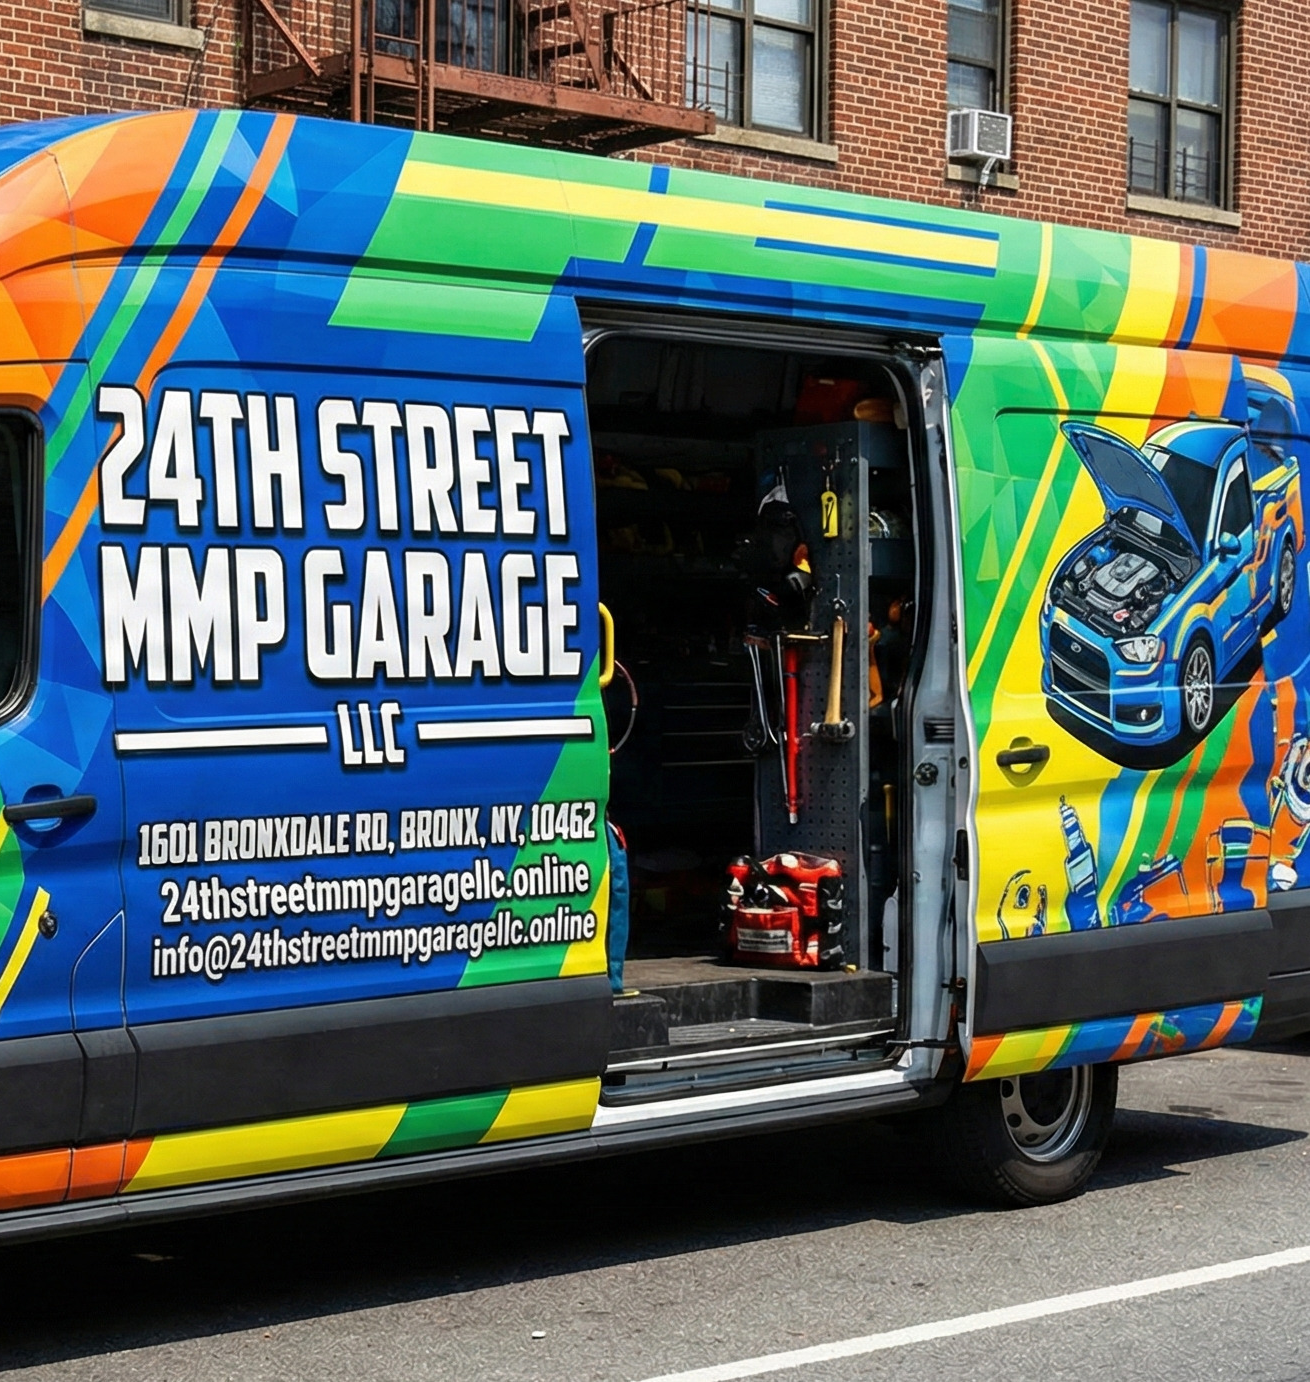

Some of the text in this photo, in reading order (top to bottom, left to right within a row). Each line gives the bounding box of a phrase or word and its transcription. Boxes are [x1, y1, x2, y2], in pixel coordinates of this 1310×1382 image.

[97, 386, 571, 537] 24TH STREET
[100, 545, 582, 683] MMP GARAGE
[337, 702, 406, 765] LLC
[137, 801, 596, 866] 1601 BRONXDALE RD, BRONX, NY, 10462
[161, 855, 590, 923] 24thstreetmmpgaragellc.online
[152, 905, 596, 980] info@24thstreetmmpgaragellc.online
